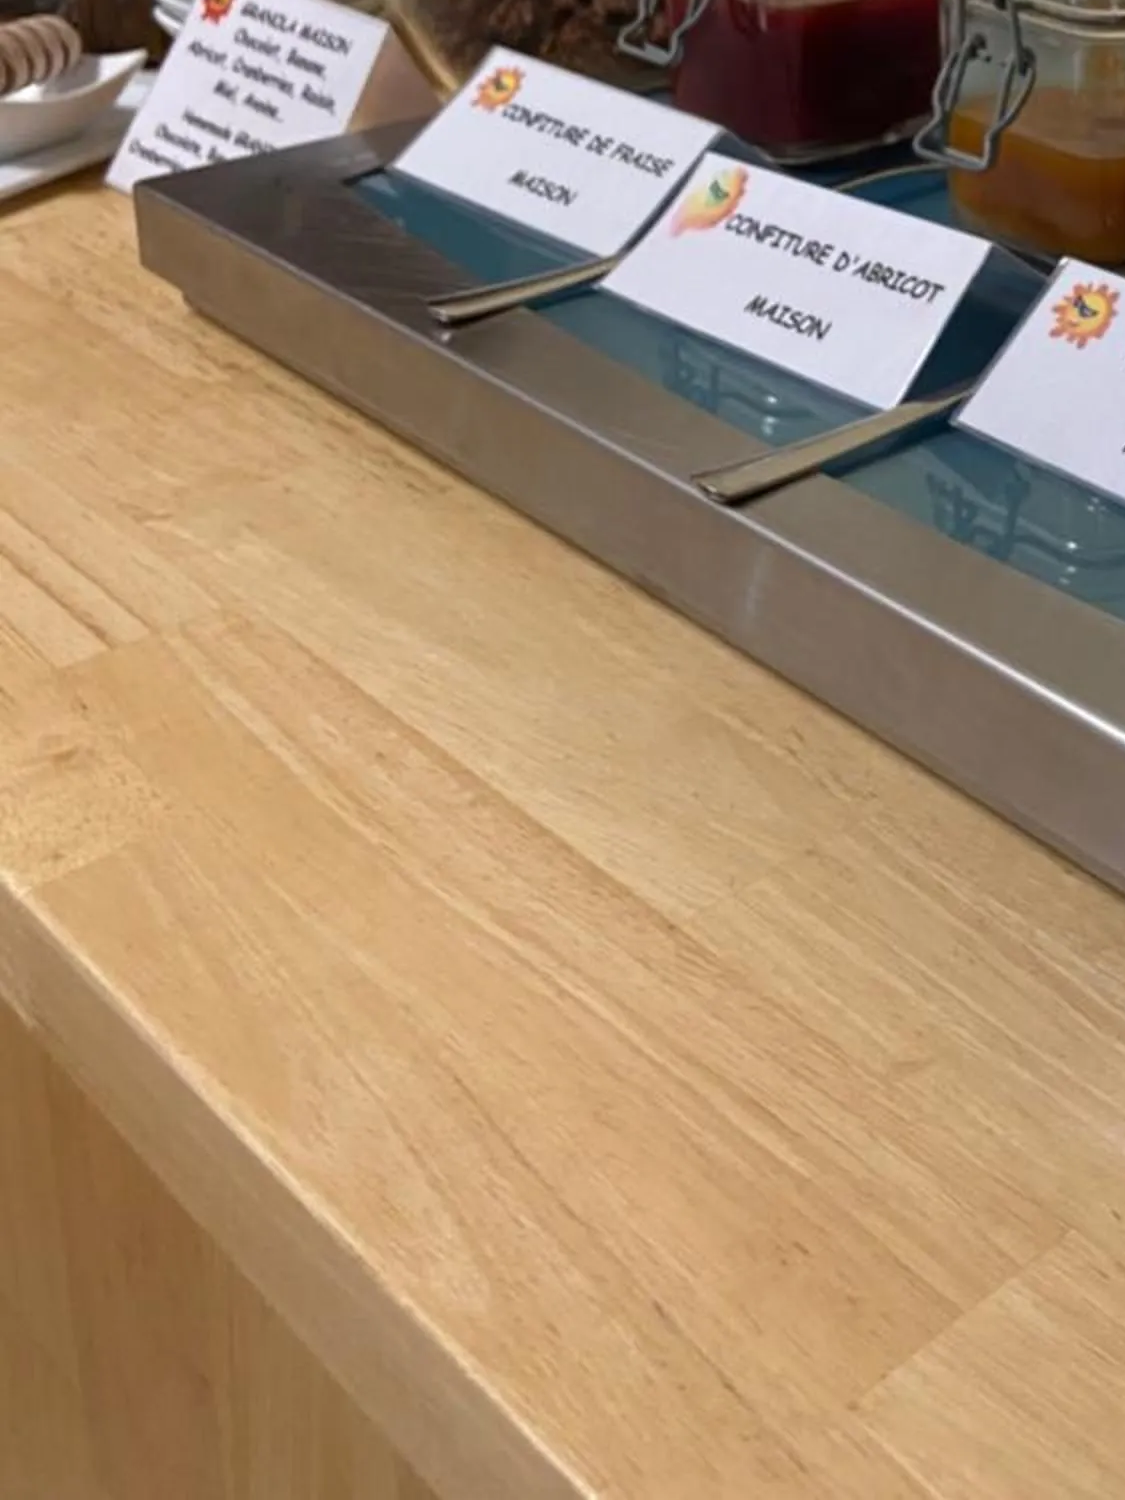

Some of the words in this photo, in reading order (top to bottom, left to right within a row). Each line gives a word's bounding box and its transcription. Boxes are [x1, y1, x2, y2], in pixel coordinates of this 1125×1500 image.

[299, 24, 352, 55] MAISON
[501, 102, 590, 149] CONFITURE
[585, 133, 614, 157] DE
[610, 142, 676, 180] FRAISE
[507, 168, 579, 208] MAISON
[725, 213, 834, 267] CONFITURE
[833, 250, 945, 304] D'ABRICOT
[744, 295, 832, 341] MAISON
